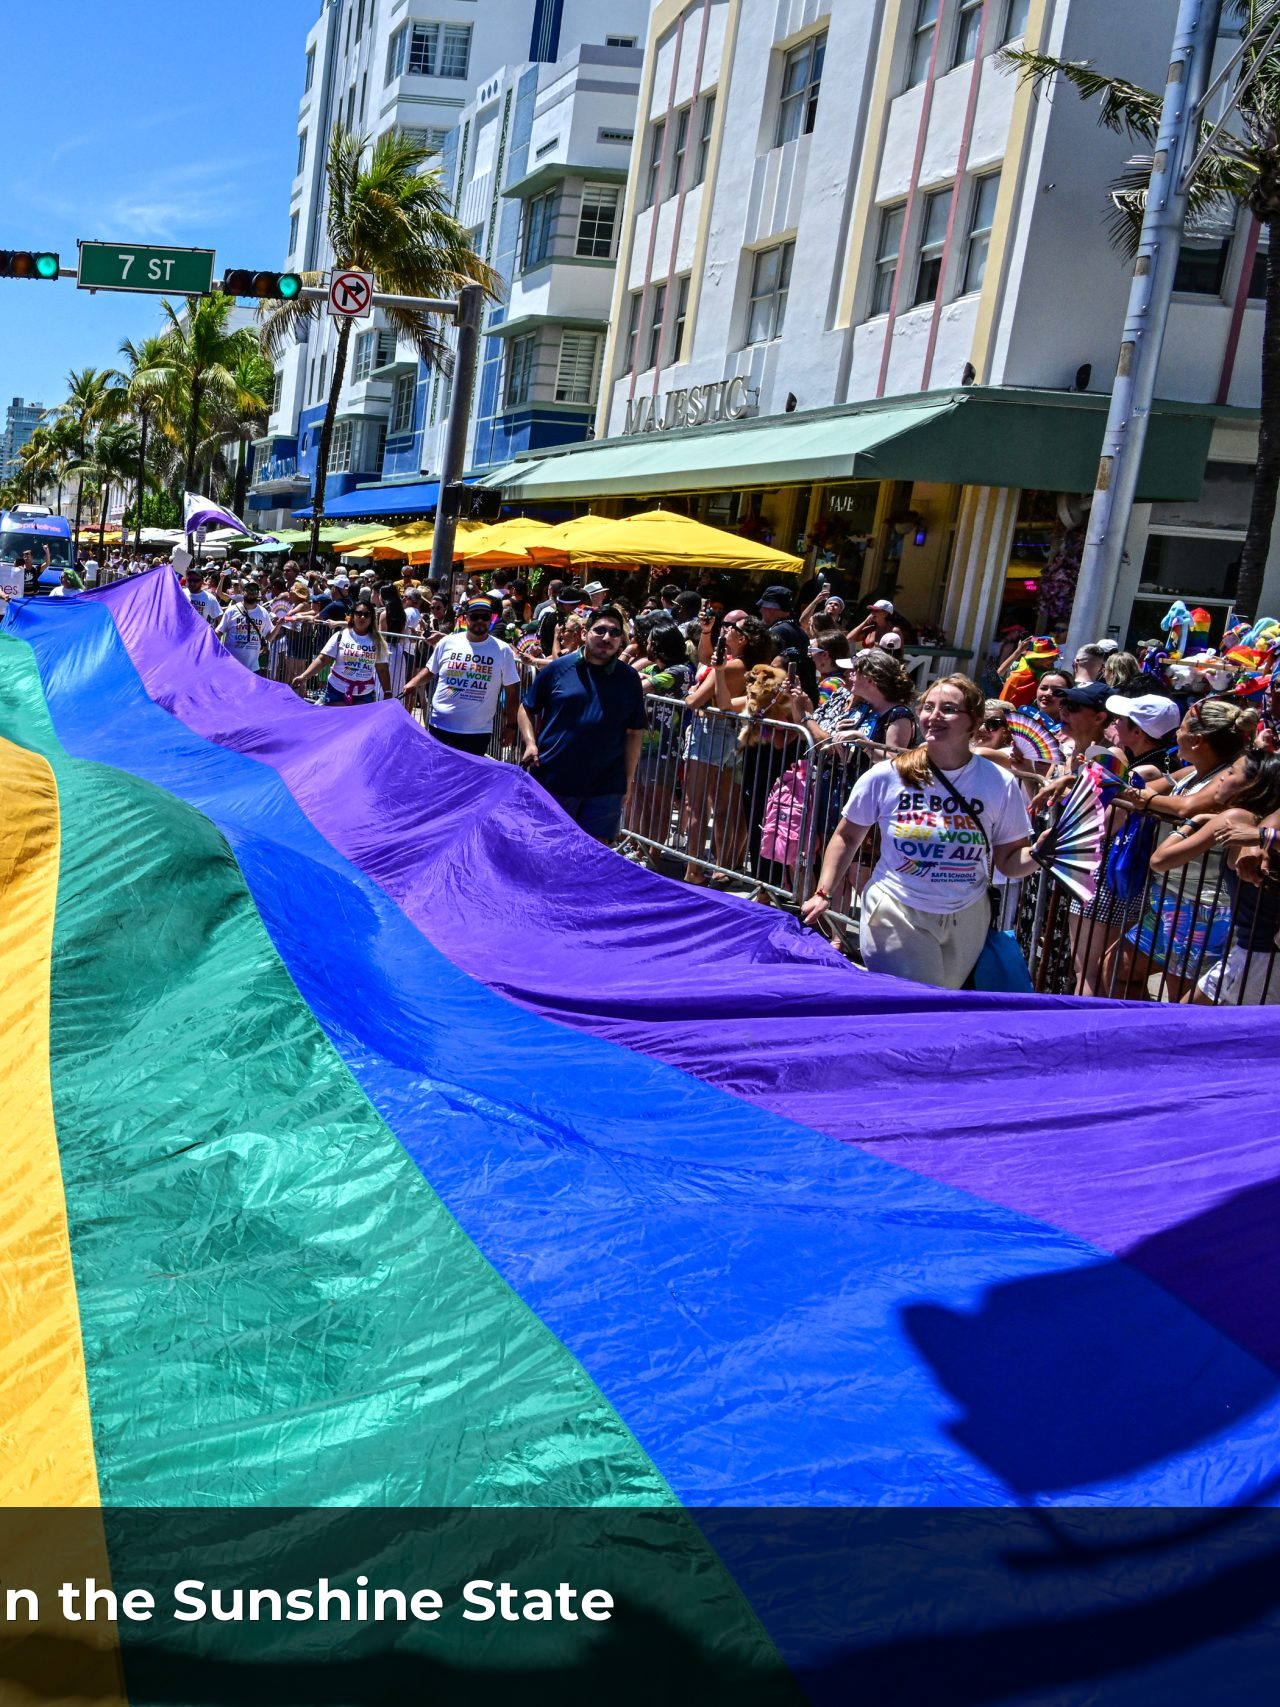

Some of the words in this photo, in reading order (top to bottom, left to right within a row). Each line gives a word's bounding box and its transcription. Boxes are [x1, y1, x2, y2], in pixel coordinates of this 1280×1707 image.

[119, 254, 135, 280] 7
[147, 258, 176, 281] ST
[622, 375, 753, 436] MAJESTIC
[450, 652, 462, 661] BE
[465, 653, 494, 665] BOLD
[447, 661, 469, 671] LIVE
[470, 664, 493, 675] FREE
[446, 677, 468, 688] LOVE
[470, 681, 488, 690] ALL
[466, 672, 492, 682] WOKE
[898, 793, 924, 811] BE
[897, 811, 937, 827] LIVE
[895, 825, 933, 841] STAY
[893, 838, 945, 859] LOVE
[949, 846, 983, 861] ALL
